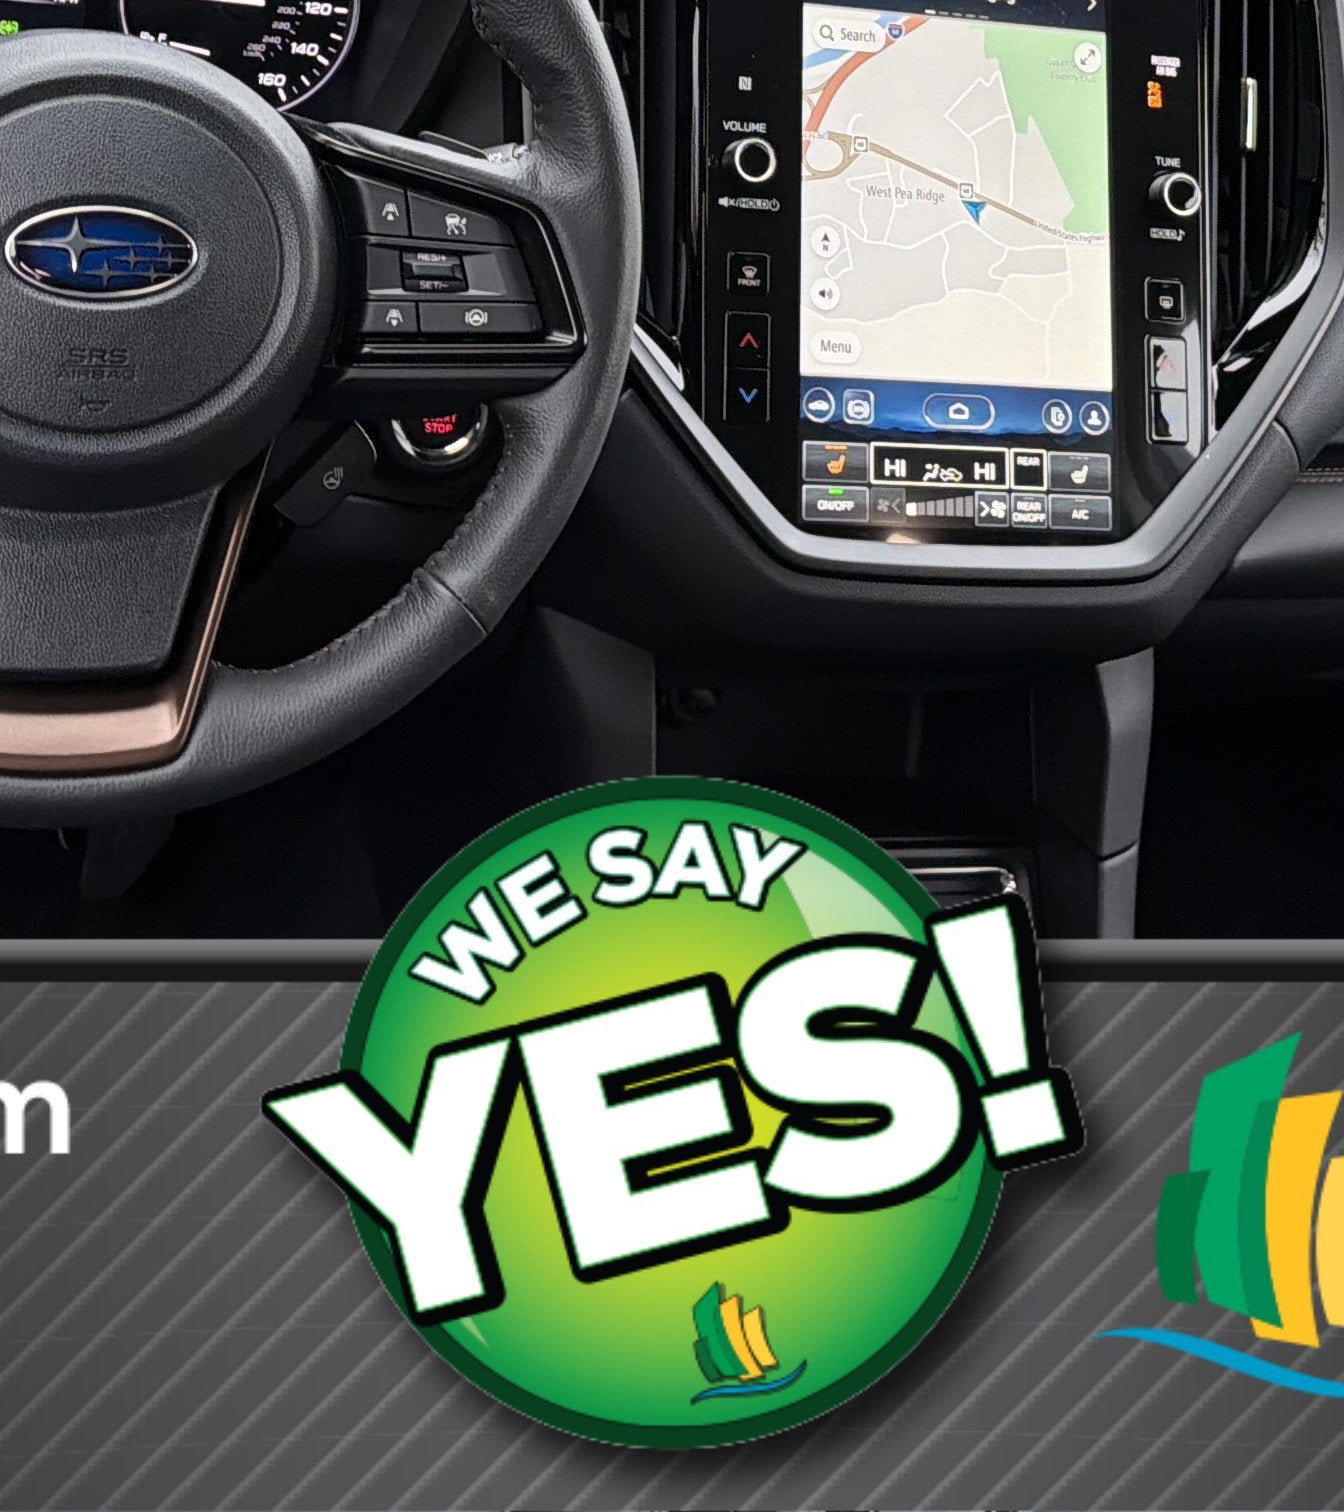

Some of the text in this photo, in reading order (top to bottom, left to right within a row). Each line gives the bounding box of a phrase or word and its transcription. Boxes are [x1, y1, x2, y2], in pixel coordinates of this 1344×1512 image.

[305, 1, 332, 16] 120
[840, 27, 876, 43] Search
[290, 42, 319, 57] 140
[258, 72, 286, 87] 160
[723, 120, 767, 133] VOLUME
[1155, 156, 1181, 168] TUNE
[866, 185, 945, 203] West Pea Ridge
[737, 277, 761, 287] FRONT
[820, 339, 852, 354] Menu
[424, 422, 453, 433] STOP
[884, 458, 906, 477] HI
[1017, 456, 1040, 466] REAR
[974, 462, 996, 481] HI
[817, 499, 854, 512] ON/OFF
[1017, 501, 1041, 511] REAR
[1012, 512, 1046, 522] ON/OFF
[1071, 509, 1090, 520] A/C
